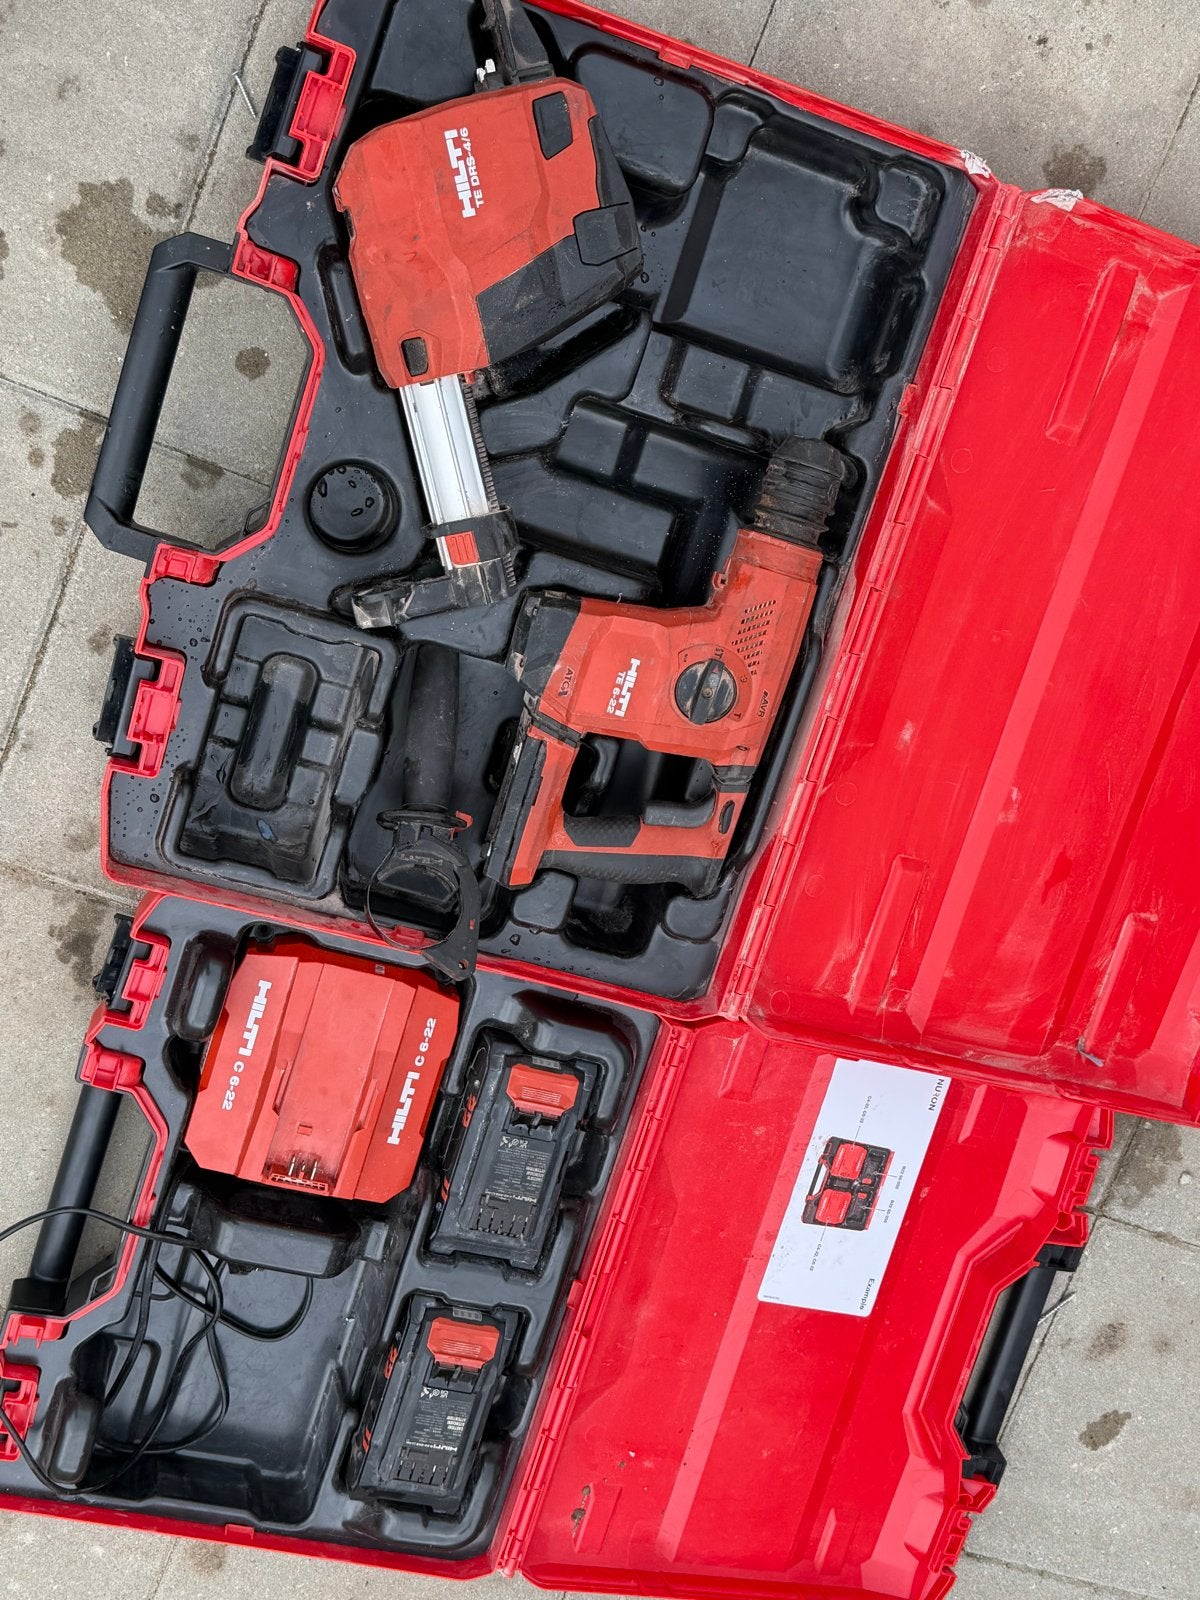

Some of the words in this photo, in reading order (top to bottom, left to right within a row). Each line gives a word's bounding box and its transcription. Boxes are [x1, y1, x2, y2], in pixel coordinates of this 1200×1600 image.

[444, 129, 476, 218] HILTI
[460, 127, 480, 187] DRS-4/6
[473, 189, 484, 208] TE
[614, 657, 641, 717] HILTI
[616, 671, 626, 685] TE
[606, 687, 621, 714] 6-22
[757, 698, 769, 718] AVR
[238, 979, 273, 1057] HILTI
[419, 1017, 437, 1052] 6-22
[233, 1061, 245, 1073] C
[414, 1055, 425, 1067] C
[221, 1075, 241, 1111] 6-22
[386, 1071, 420, 1145] HILTI
[928, 1078, 945, 1111] NURON
[859, 1278, 875, 1310] Example
